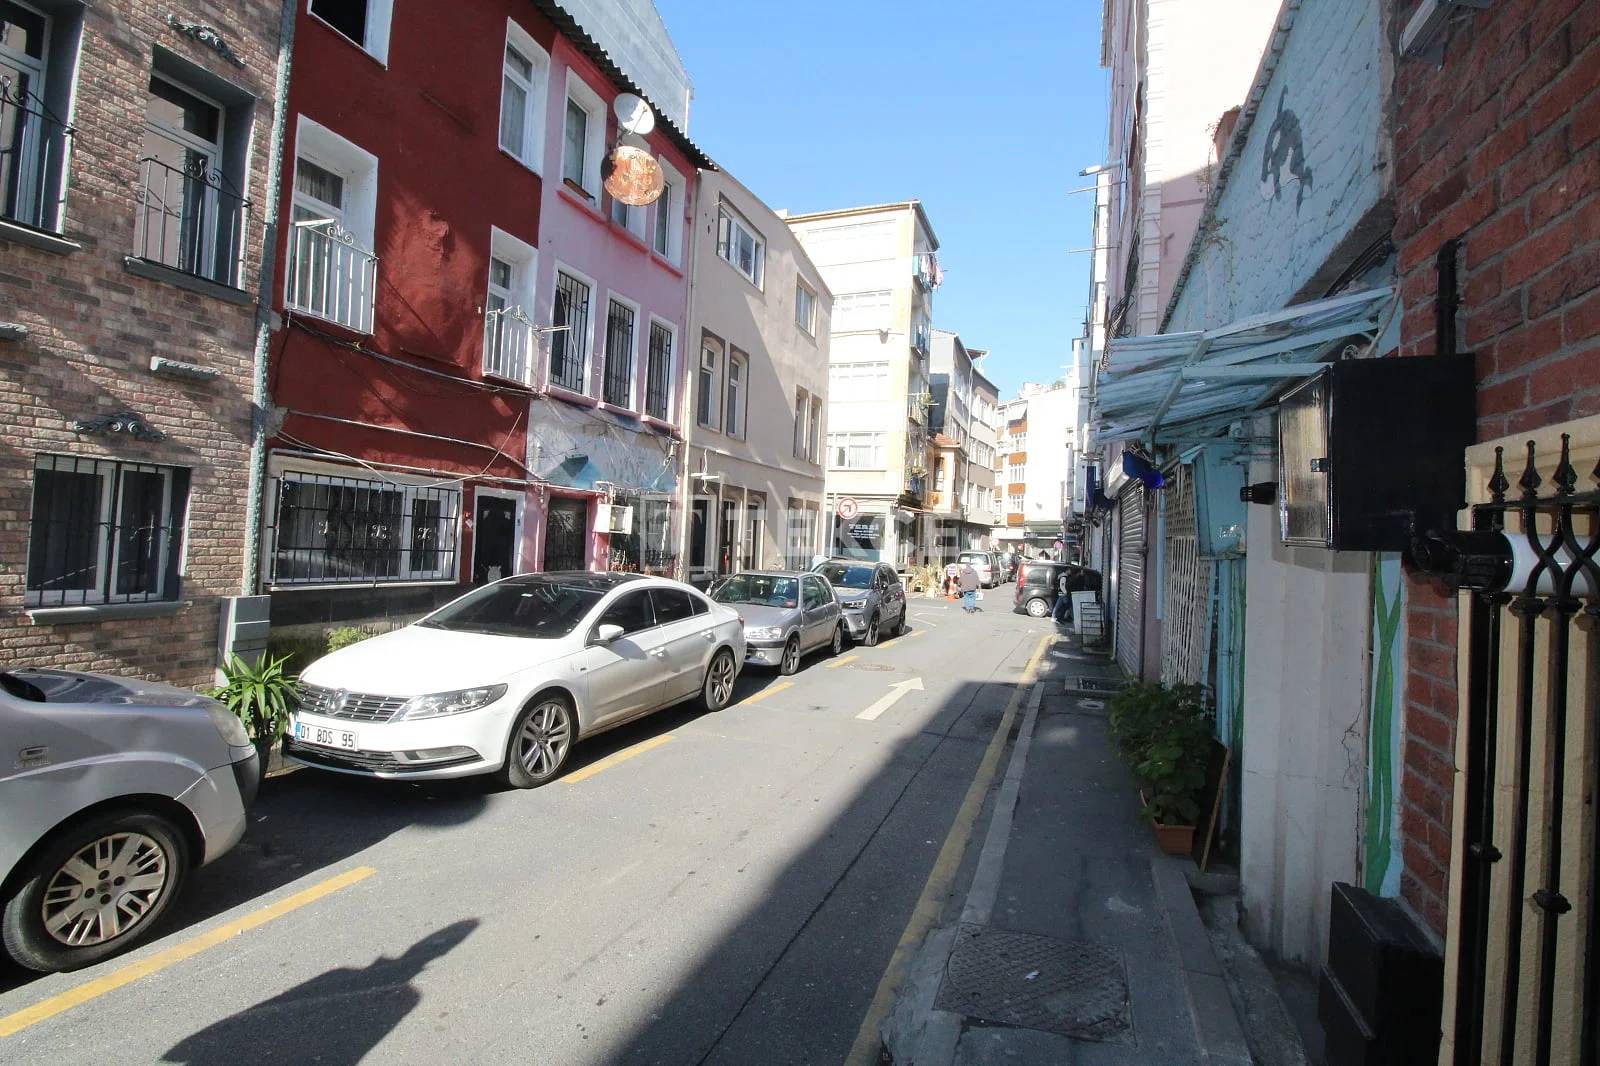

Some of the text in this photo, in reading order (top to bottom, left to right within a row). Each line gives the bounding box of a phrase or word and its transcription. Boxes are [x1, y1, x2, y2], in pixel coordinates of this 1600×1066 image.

[300, 725, 310, 739] 01
[316, 728, 333, 744] BDS
[342, 733, 354, 748] 95
